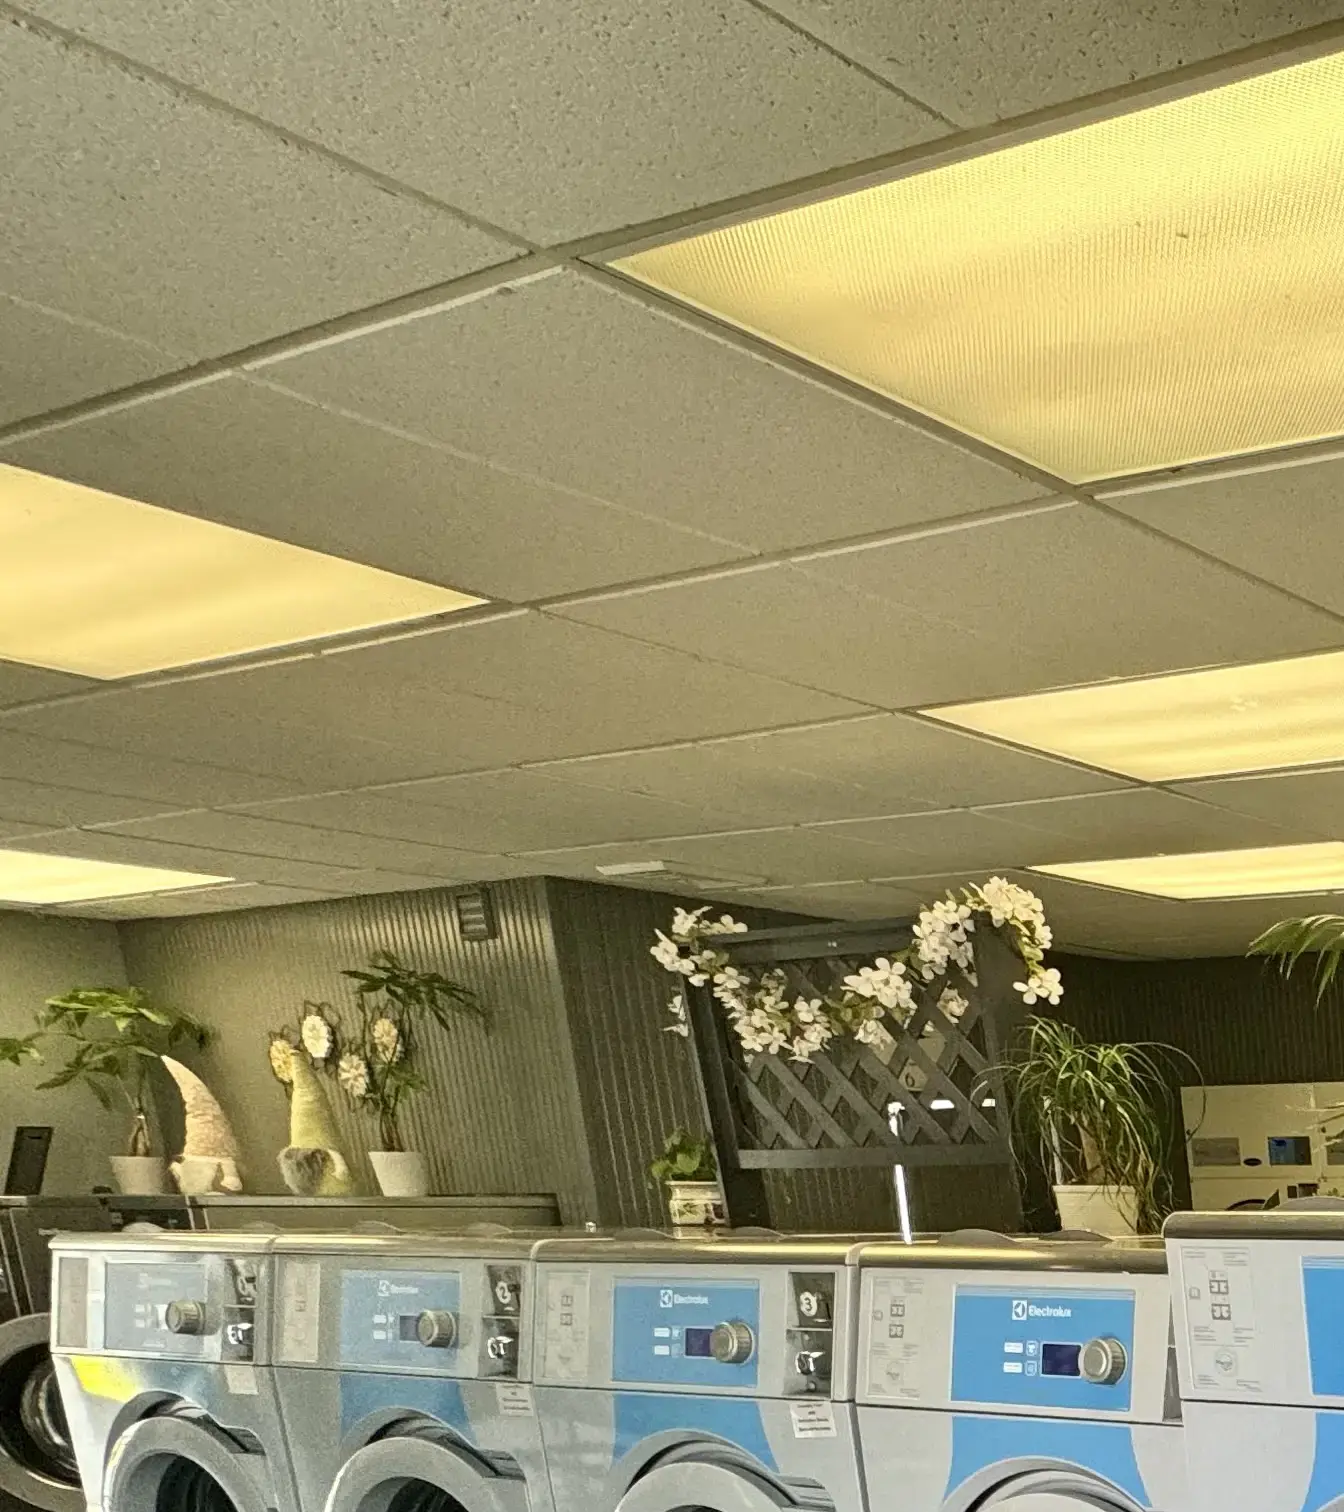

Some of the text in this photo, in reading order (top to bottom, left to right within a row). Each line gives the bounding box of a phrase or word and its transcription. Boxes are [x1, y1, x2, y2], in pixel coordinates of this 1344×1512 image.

[499, 1286, 507, 1300] 2
[804, 1297, 813, 1312] 3
[1028, 1304, 1072, 1318] Electrolux
